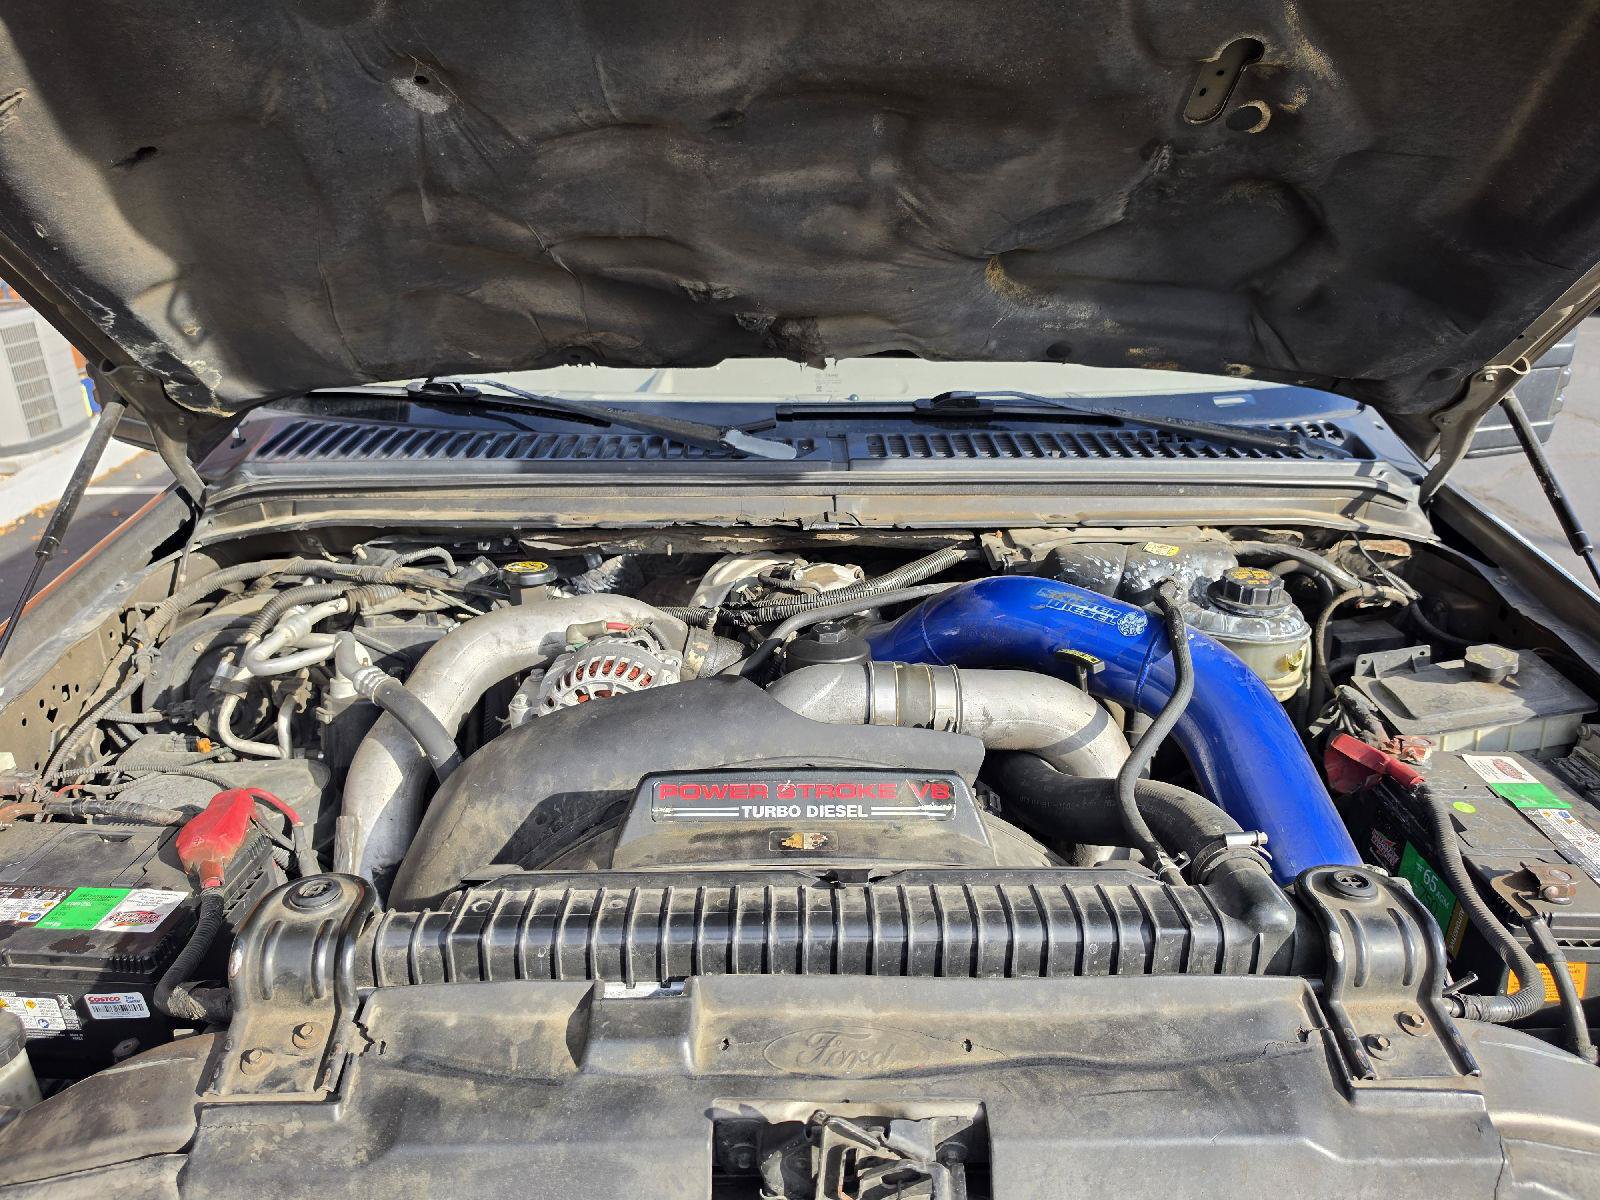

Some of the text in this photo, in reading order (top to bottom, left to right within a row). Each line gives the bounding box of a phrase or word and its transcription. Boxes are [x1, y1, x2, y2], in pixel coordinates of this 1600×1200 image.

[659, 782, 951, 800] POWER STROKE V8
[741, 805, 869, 818] TURBO DIESEL
[1423, 869, 1439, 892] 65
[796, 1031, 897, 1070] Ford
